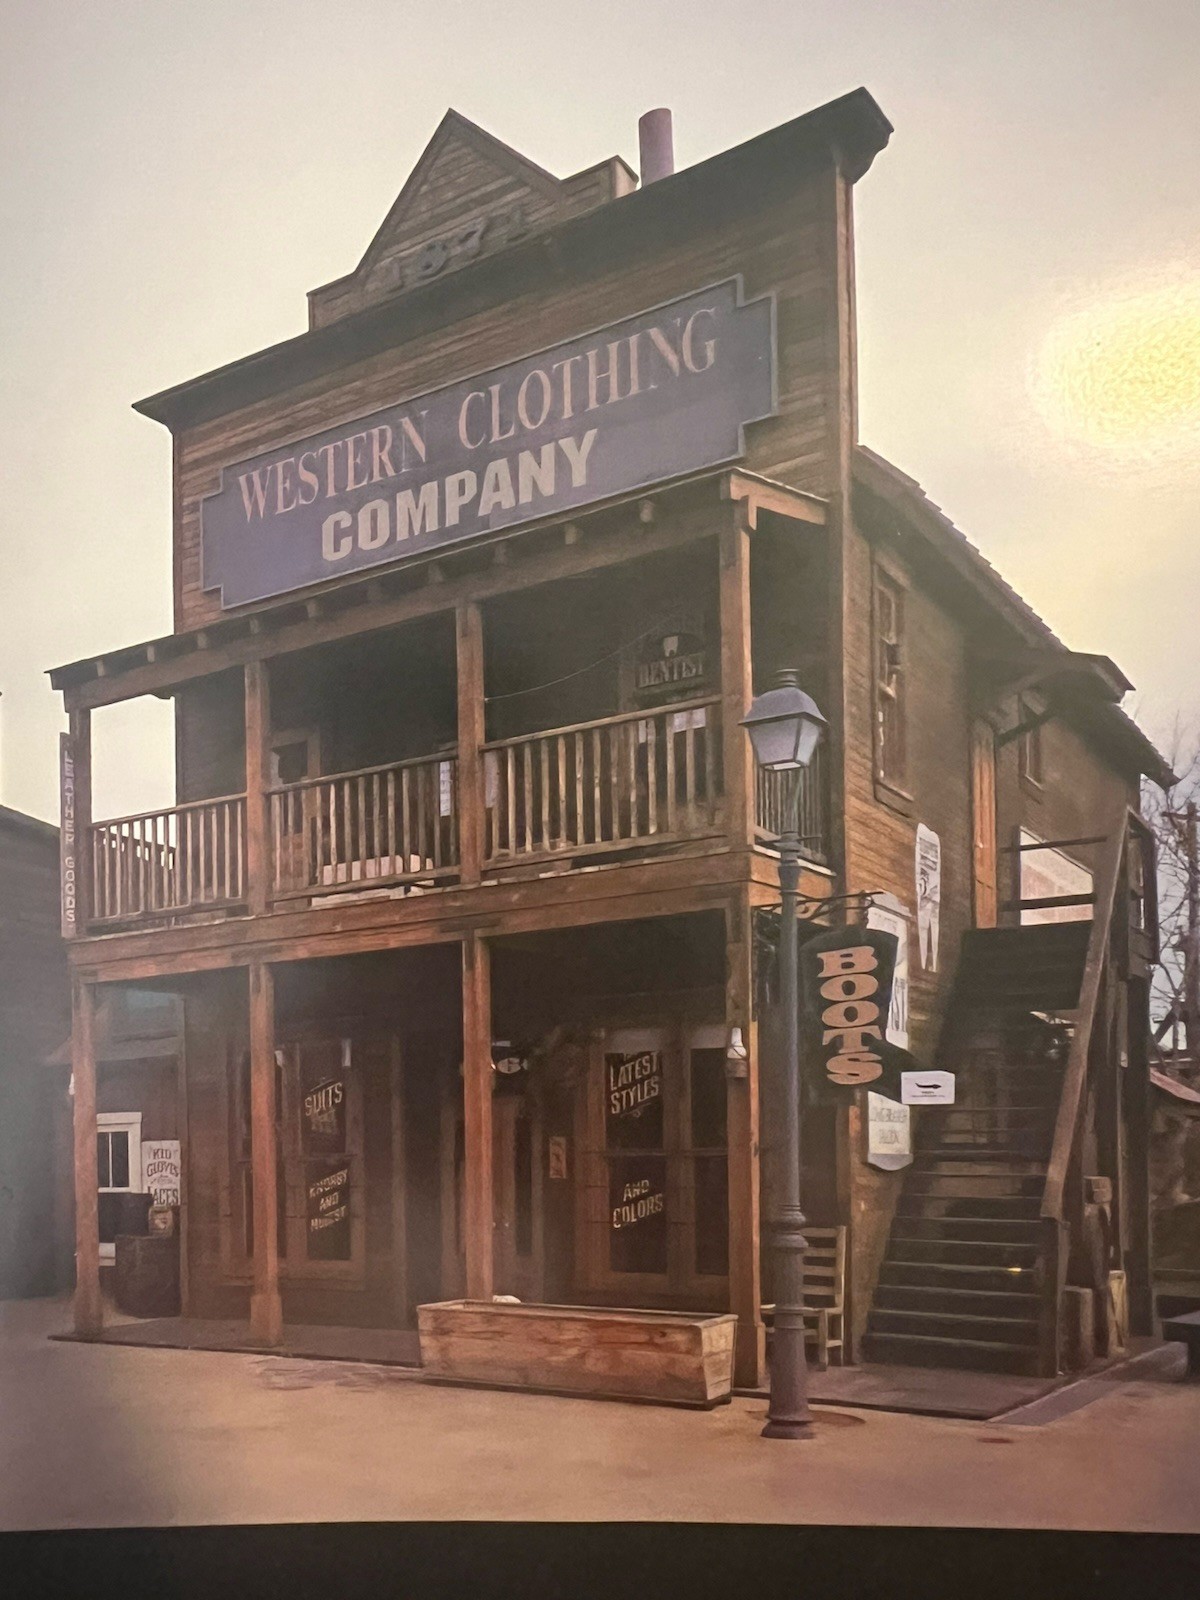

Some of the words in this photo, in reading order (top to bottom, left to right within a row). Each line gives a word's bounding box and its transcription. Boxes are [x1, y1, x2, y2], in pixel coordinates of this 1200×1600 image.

[238, 410, 429, 523] WESTERN
[458, 307, 718, 451] CLOTHING
[322, 428, 597, 562] COMPANY
[639, 654, 704, 687] DENTIST
[64, 751, 75, 845] LEATHER
[65, 856, 75, 922] GOODS
[817, 946, 882, 1085] BOOTS
[610, 1051, 659, 1091] LATEST
[304, 1082, 343, 1116] SUITS
[611, 1076, 659, 1114] STYLES
[147, 1161, 179, 1178] GLOVES
[153, 1149, 172, 1160] KID
[319, 1191, 339, 1210] AND
[623, 1180, 649, 1202] AND
[613, 1193, 663, 1228] COLORS
